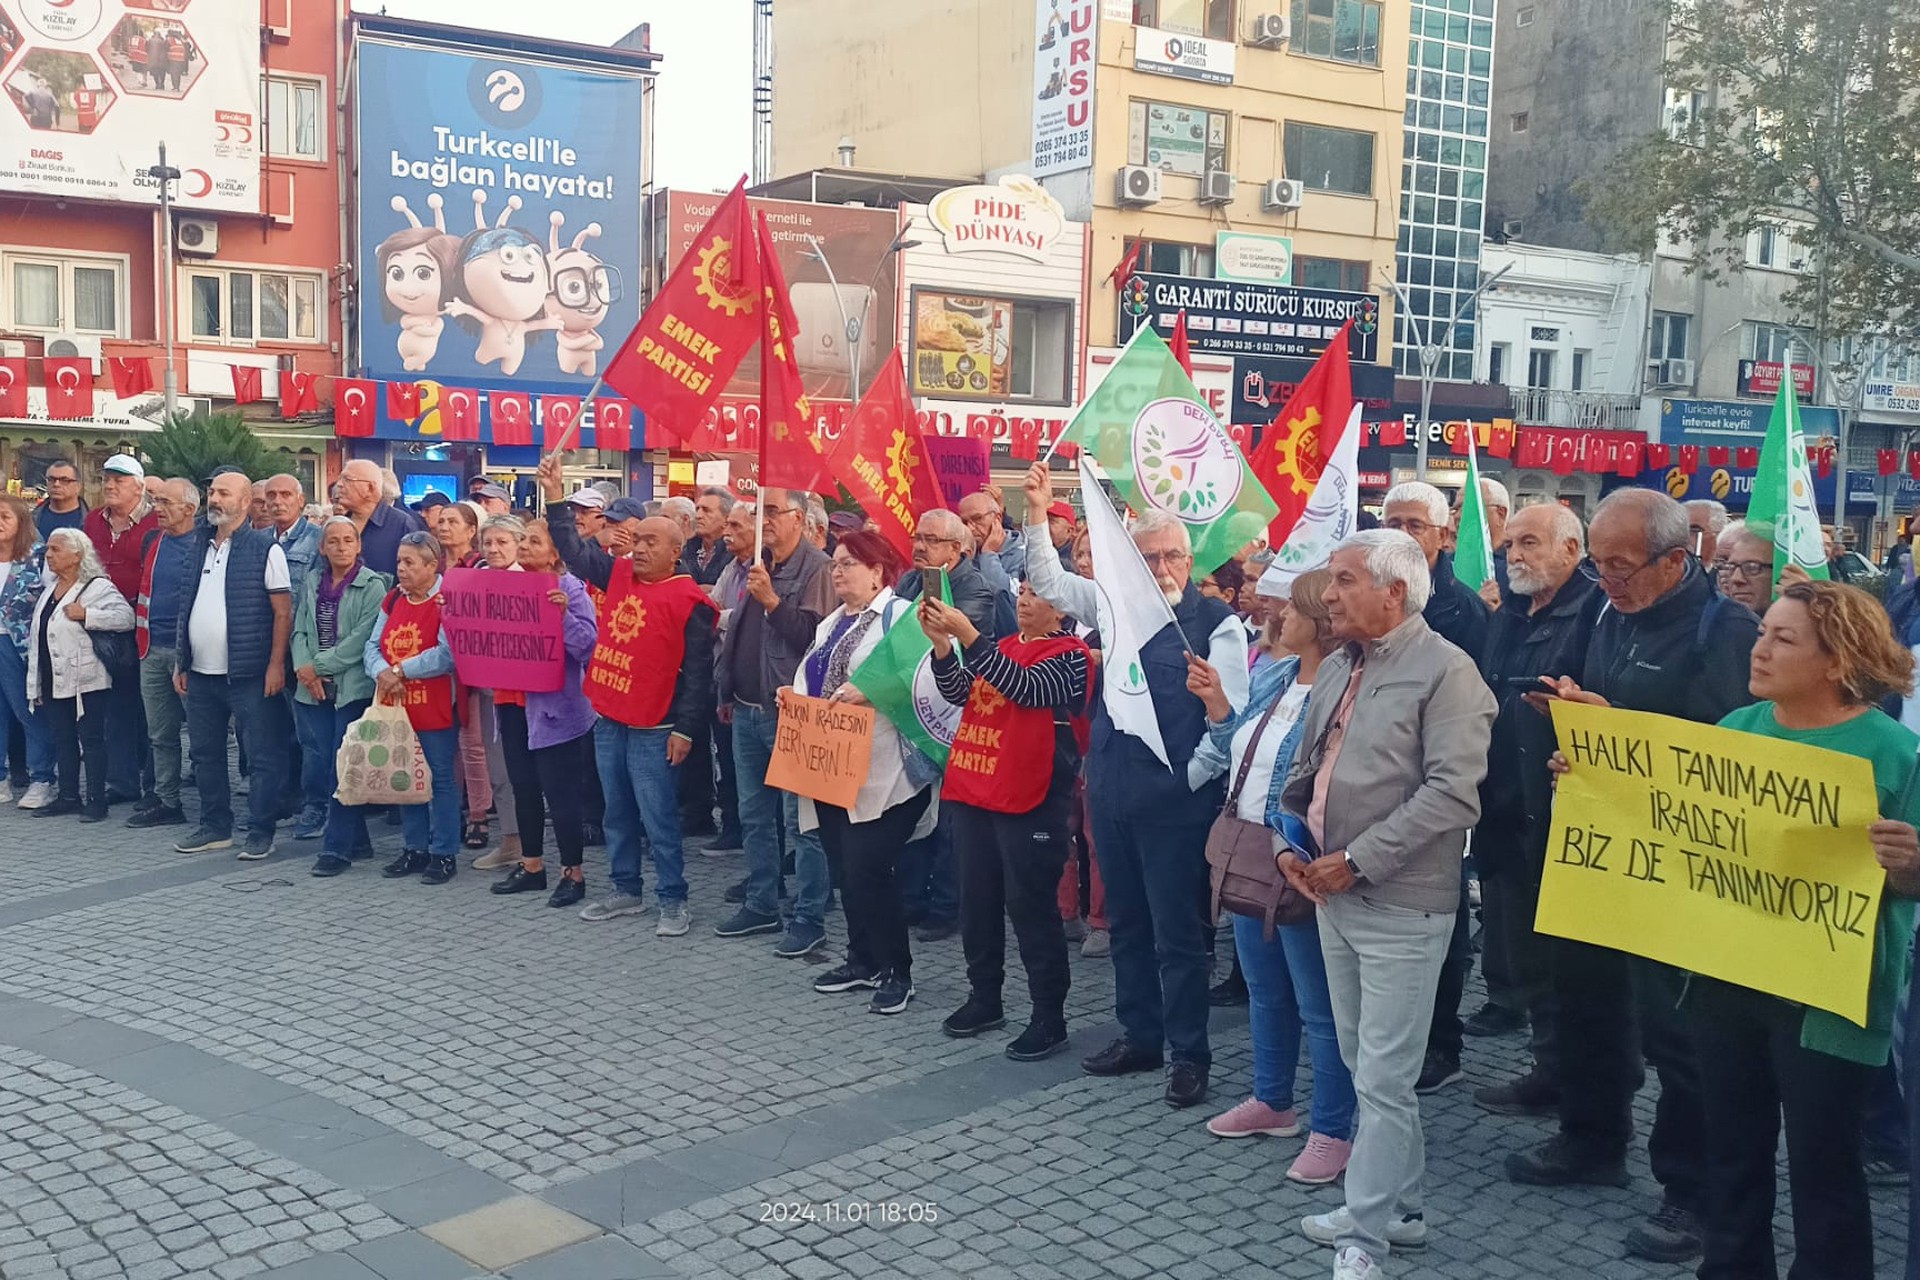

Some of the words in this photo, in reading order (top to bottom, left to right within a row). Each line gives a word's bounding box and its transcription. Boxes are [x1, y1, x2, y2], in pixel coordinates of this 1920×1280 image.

[1068, 0, 1092, 127] URSU
[433, 125, 577, 167] Turkcell'le
[1035, 139, 1052, 154] 0266
[1054, 136, 1067, 151] 374
[1068, 133, 1078, 147] 33
[1079, 130, 1089, 143] 35
[1035, 155, 1052, 168] 0531
[1053, 150, 1067, 164] 794
[1068, 148, 1078, 160] 80
[1078, 145, 1088, 158] 43
[216, 181, 247, 192] KIZILAY
[390, 150, 496, 188] bağlan
[504, 163, 614, 200] hayata!
[799, 213, 812, 226] ile
[974, 195, 1026, 221] PİDE
[955, 219, 1044, 251] DÜNYASI
[1155, 283, 1232, 311] GARANTİ
[1234, 285, 1299, 316] SÜRÜCÜ
[1302, 295, 1356, 321] KURSU
[659, 313, 722, 365] EMEK
[637, 335, 716, 396] PARTİSİ
[1866, 384, 1893, 396] UMRE
[1887, 398, 1905, 410] 0532
[1906, 400, 1919, 411] 428
[103, 417, 130, 425] YUFKA
[1682, 415, 1720, 428] internet
[1723, 418, 1750, 431] keyfi!
[851, 453, 889, 499] EMEK
[1428, 458, 1451, 469] TEKNİK
[485, 588, 540, 623] İRADESİNİ
[593, 643, 634, 671] EMEK
[815, 704, 868, 737] İRADESİNİ
[919, 696, 937, 724] DEM
[957, 721, 1003, 749] EMEK
[1571, 728, 1653, 779] HALKI
[1668, 745, 1841, 828] TANIMAYAN
[1649, 785, 1749, 857] İRADEYİ
[1554, 823, 1612, 872] BİZ
[1623, 837, 1666, 885] DE
[1679, 848, 1872, 953] TANIMIYORUZ
